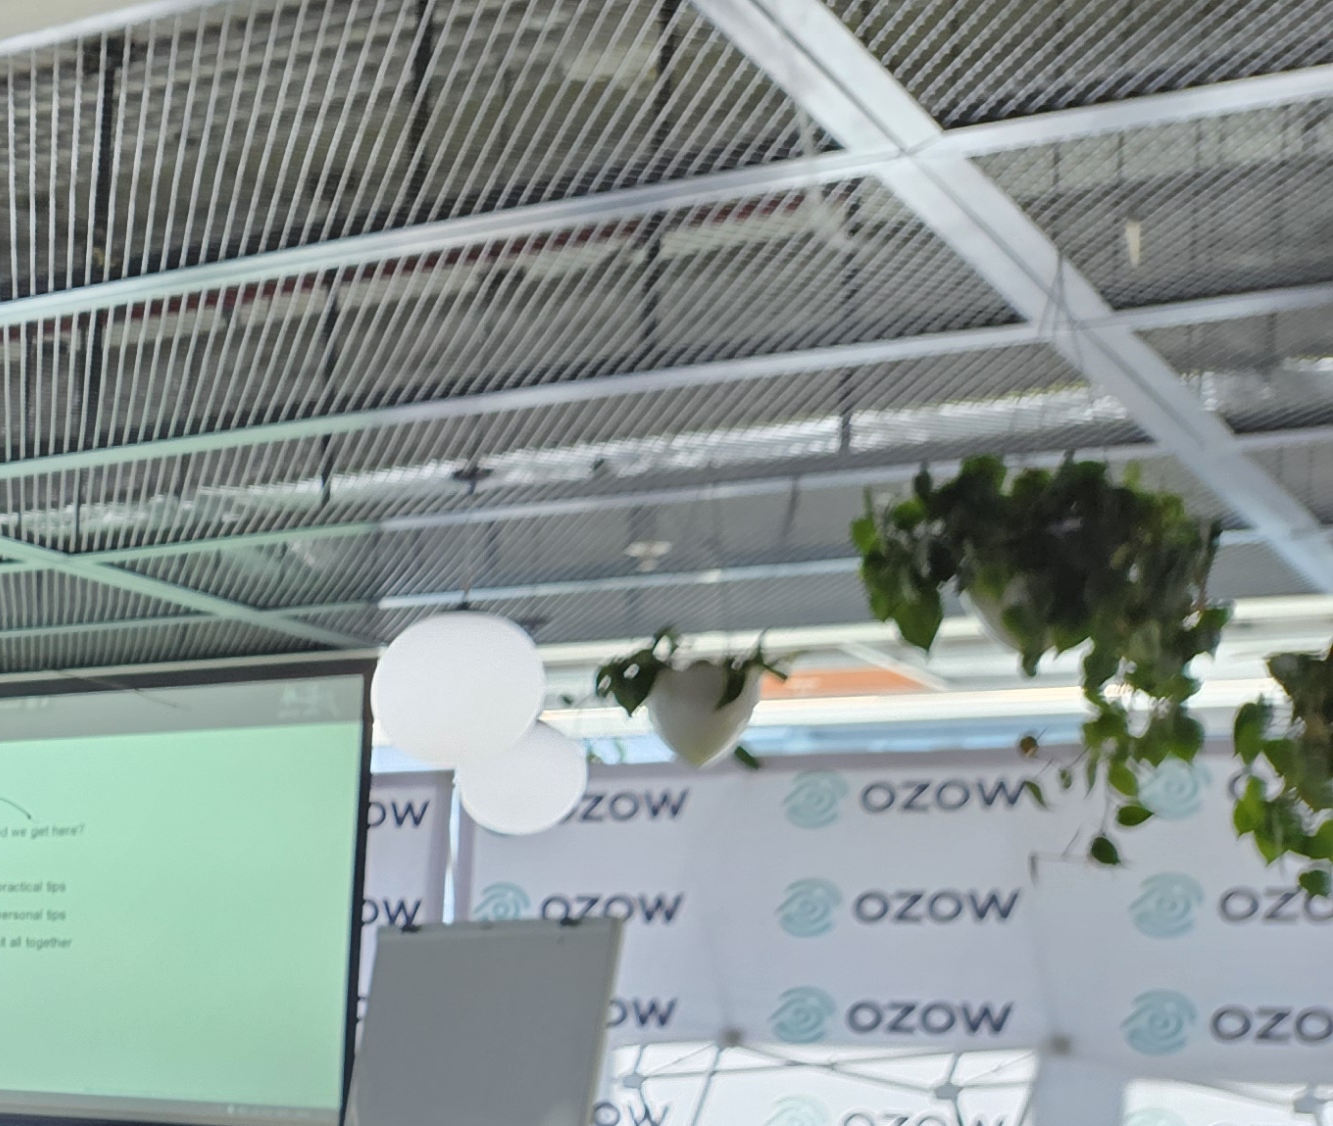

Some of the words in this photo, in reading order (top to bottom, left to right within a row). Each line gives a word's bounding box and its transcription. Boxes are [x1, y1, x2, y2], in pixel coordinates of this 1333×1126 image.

[564, 788, 689, 825] ZOW
[860, 779, 1027, 813] OZOW
[367, 800, 429, 828] OW
[12, 828, 27, 838] we
[30, 825, 49, 840] get
[52, 824, 85, 837] here?
[46, 881, 66, 894] tips
[46, 909, 66, 922] tips
[361, 898, 423, 927] OW
[853, 889, 1021, 924] OZOW
[1218, 885, 1333, 924] OZO
[10, 936, 21, 948] all
[25, 936, 73, 950] together
[605, 997, 678, 1028] OW
[845, 1000, 1014, 1035] OZOW
[1210, 1004, 1333, 1043] OZO
